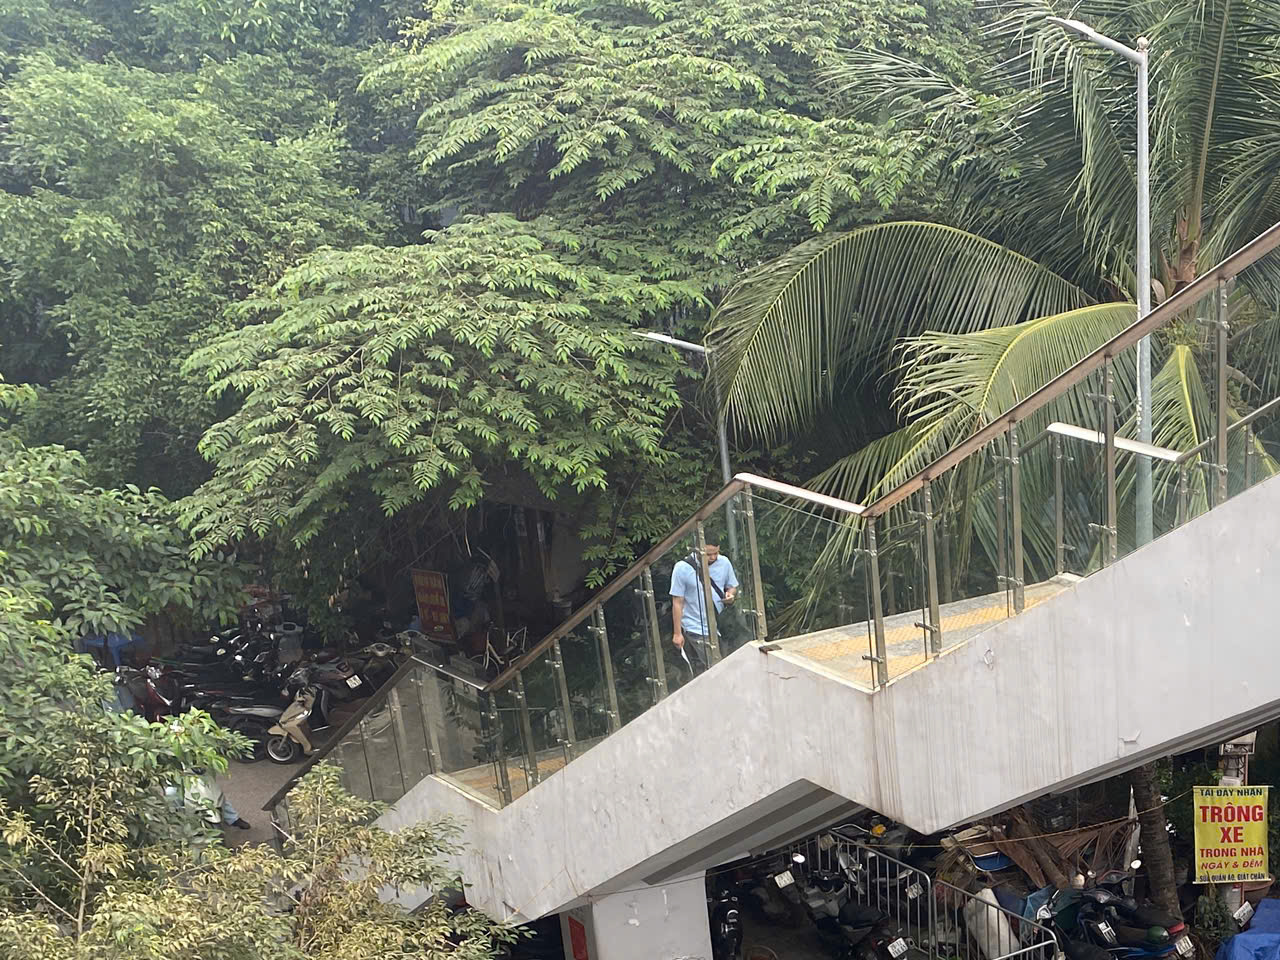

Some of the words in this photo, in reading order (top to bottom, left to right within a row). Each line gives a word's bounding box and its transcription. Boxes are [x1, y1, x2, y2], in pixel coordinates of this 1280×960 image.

[1200, 802, 1264, 823] TRÔNG
[1220, 826, 1244, 843] XE
[1200, 847, 1237, 858] TRONG
[1232, 861, 1239, 869] &
